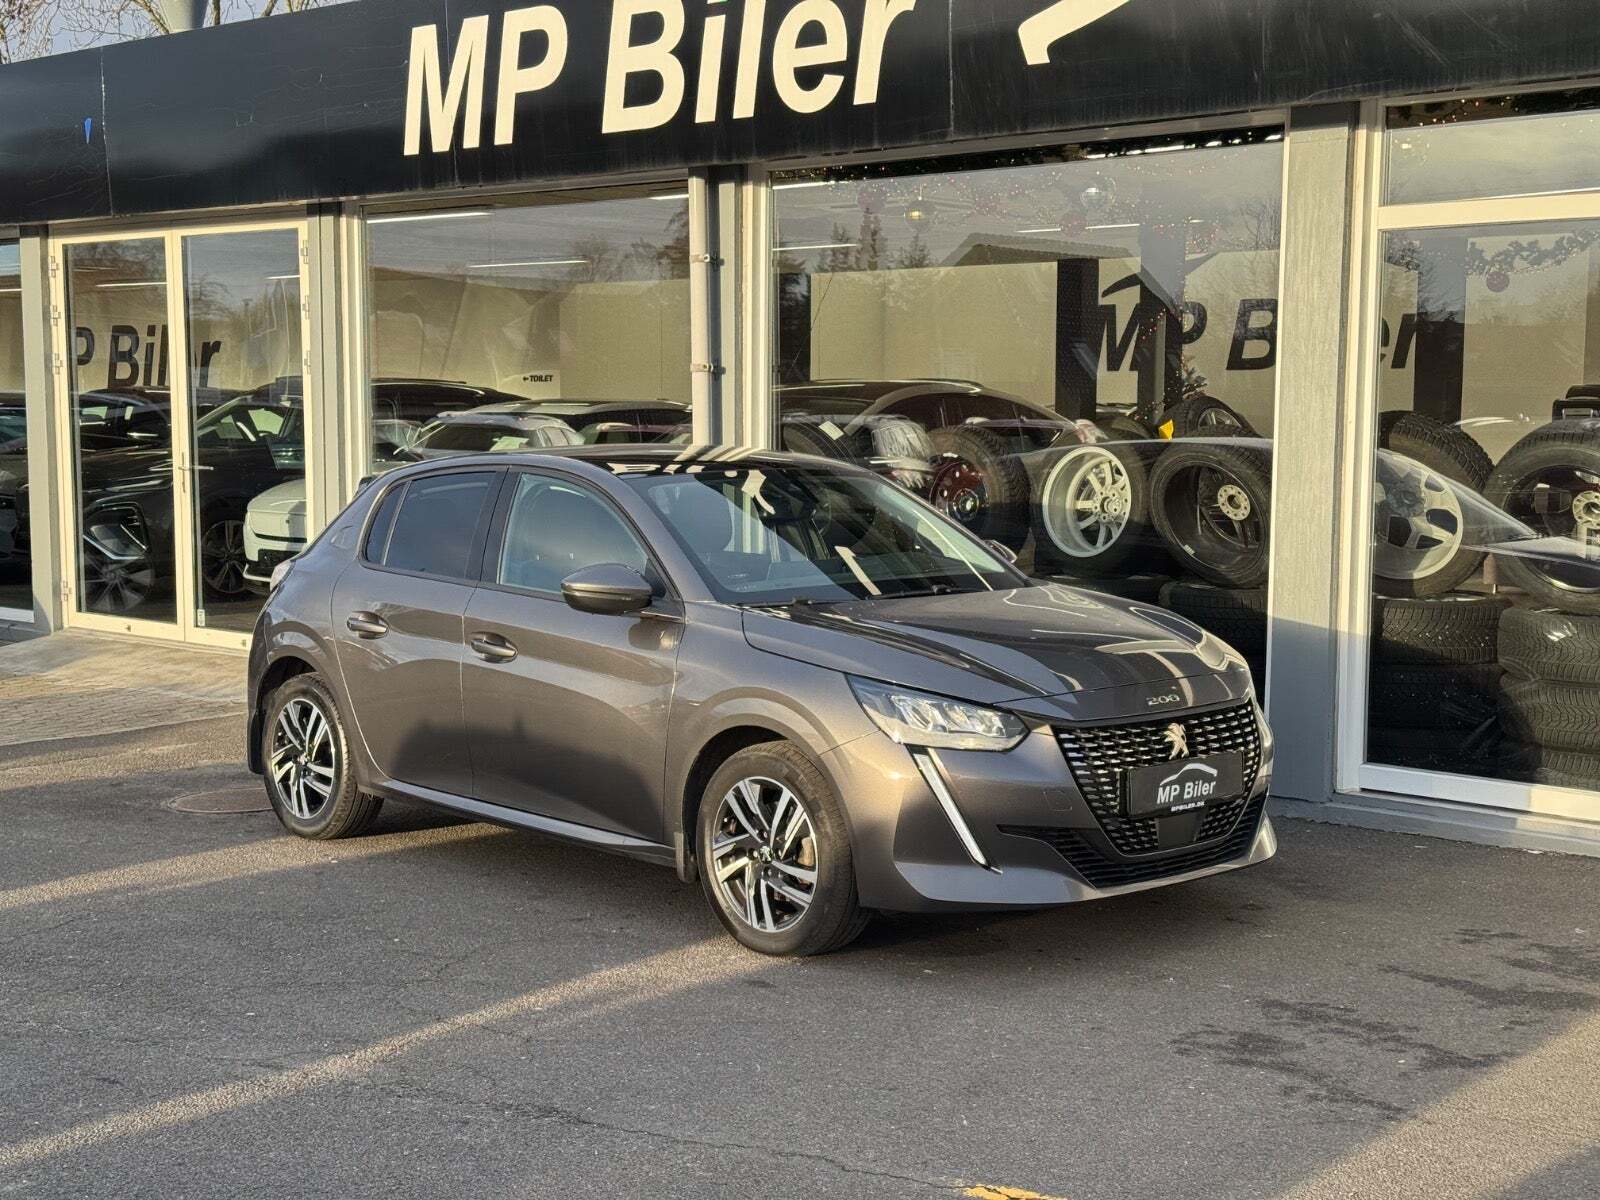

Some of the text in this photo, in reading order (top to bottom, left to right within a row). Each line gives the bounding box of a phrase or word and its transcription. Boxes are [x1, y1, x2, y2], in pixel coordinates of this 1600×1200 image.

[403, 0, 918, 156] MP Biler
[107, 324, 222, 389] Bilr
[529, 374, 554, 383] TOILET
[1156, 780, 1216, 805] MP Biler
